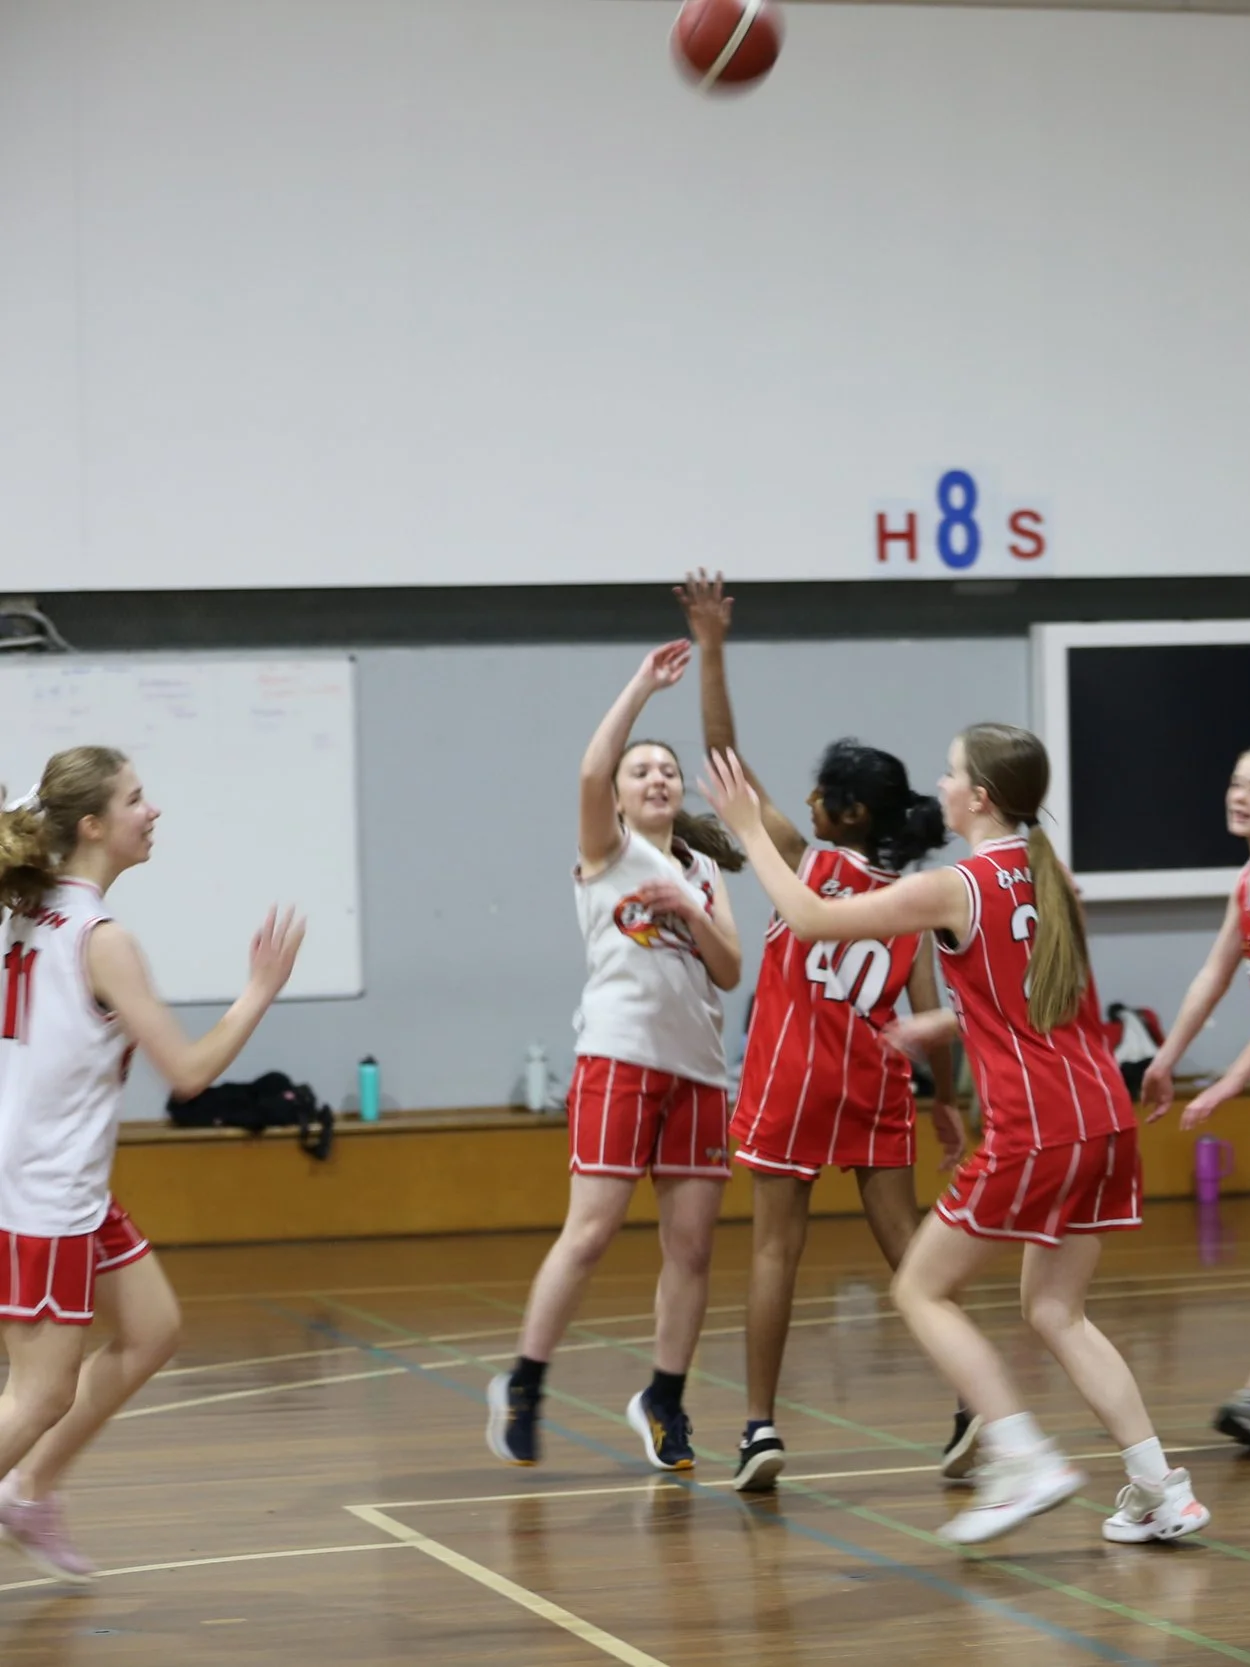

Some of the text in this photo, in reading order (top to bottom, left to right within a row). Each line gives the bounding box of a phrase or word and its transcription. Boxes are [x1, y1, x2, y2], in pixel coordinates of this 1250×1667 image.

[876, 469, 1046, 570] H 8 S
[805, 940, 891, 1018] 40
